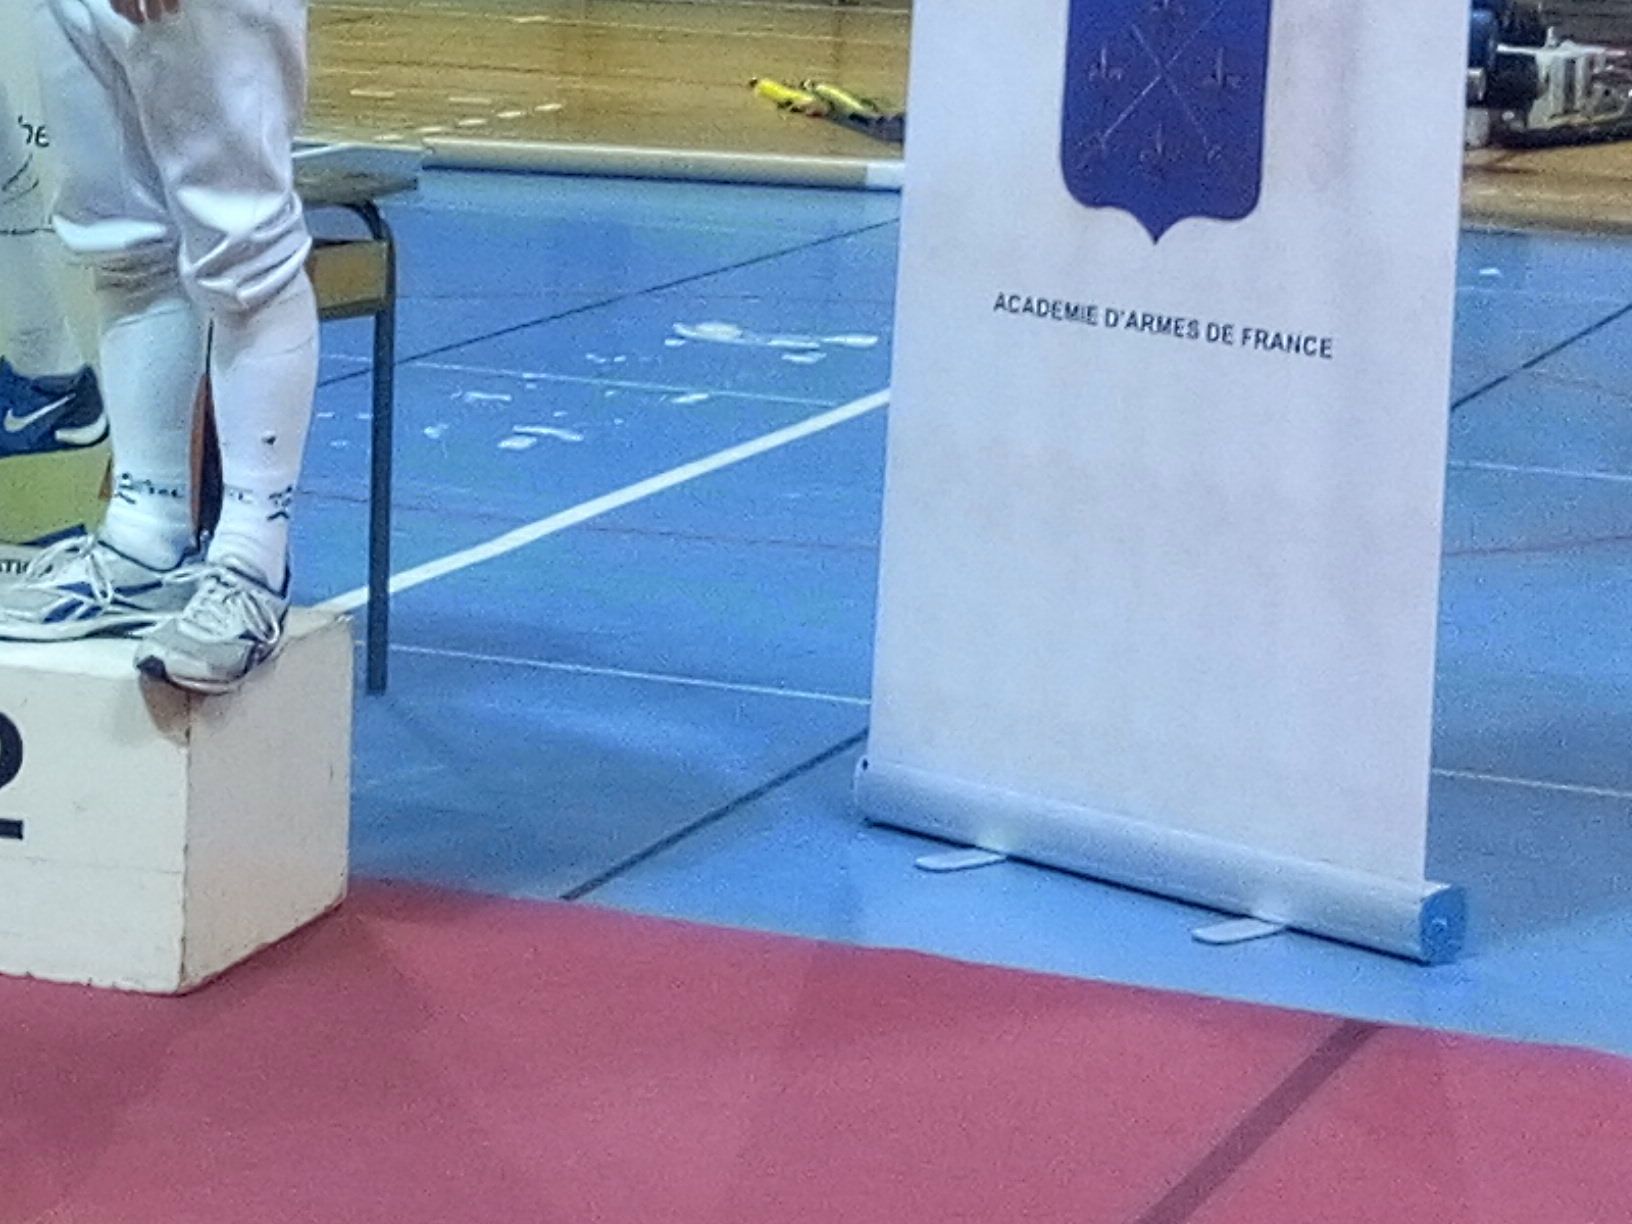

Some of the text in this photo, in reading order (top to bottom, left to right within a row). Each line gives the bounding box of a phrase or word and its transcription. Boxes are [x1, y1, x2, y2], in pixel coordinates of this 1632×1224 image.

[993, 291, 1335, 360] ACADEMIE D'ARMES DE FRANCE
